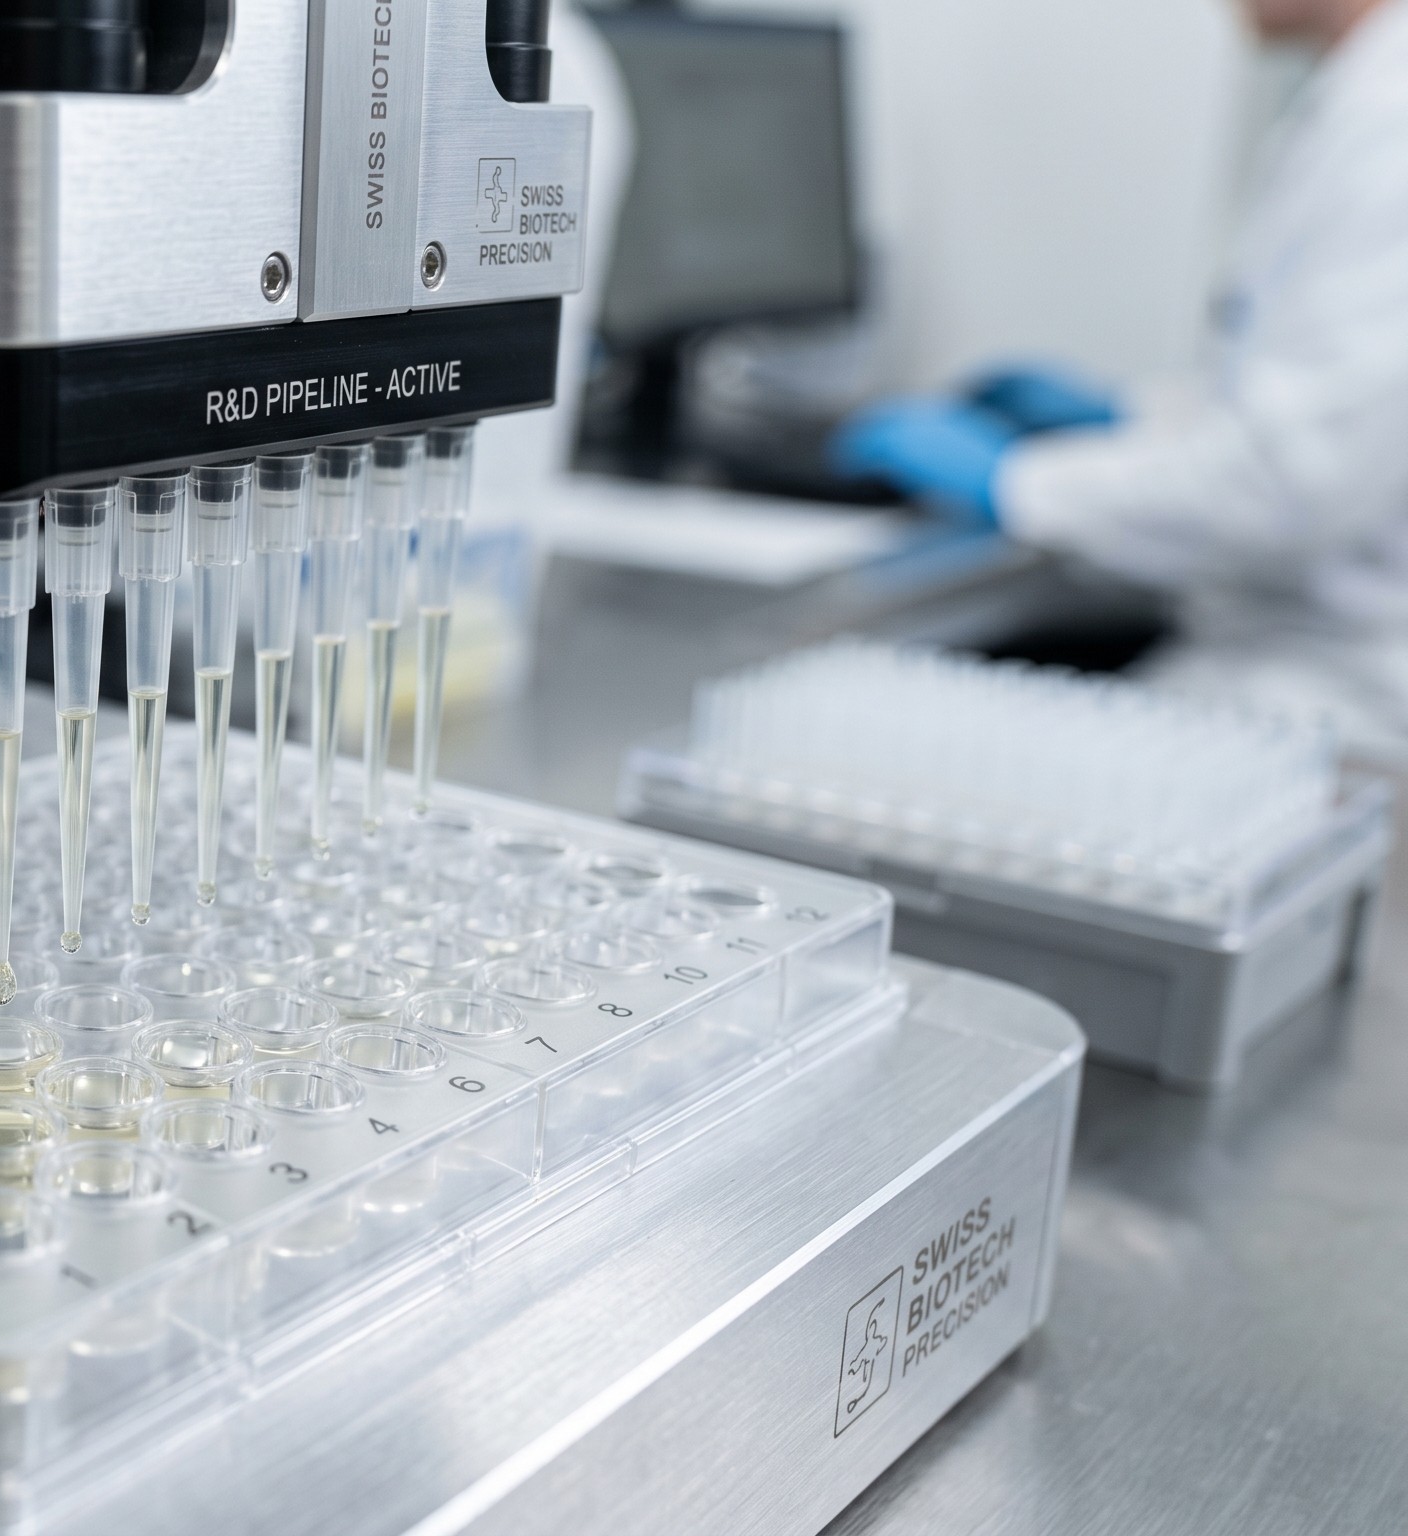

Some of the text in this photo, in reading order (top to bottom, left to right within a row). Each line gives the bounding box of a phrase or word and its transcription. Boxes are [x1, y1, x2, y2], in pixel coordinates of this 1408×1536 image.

[366, 0, 392, 229] SWISS BIOTEC
[520, 185, 564, 207] SWISS
[519, 212, 577, 235] BIOTECH
[479, 241, 552, 266] PRECISION
[206, 386, 259, 425] R&D
[266, 371, 369, 416] PIPELINE
[386, 360, 462, 400] ACTIVE
[664, 966, 707, 984] 10
[598, 1003, 633, 1018] 8
[524, 1036, 558, 1053] 7
[449, 1076, 486, 1093] 6
[369, 1118, 399, 1134] 4
[270, 1163, 308, 1183] 3
[166, 1210, 213, 1237] 2
[912, 1197, 991, 1285] SWISS
[906, 1217, 1016, 1335] BIOTECH
[902, 1262, 1011, 1377] PRECISION
